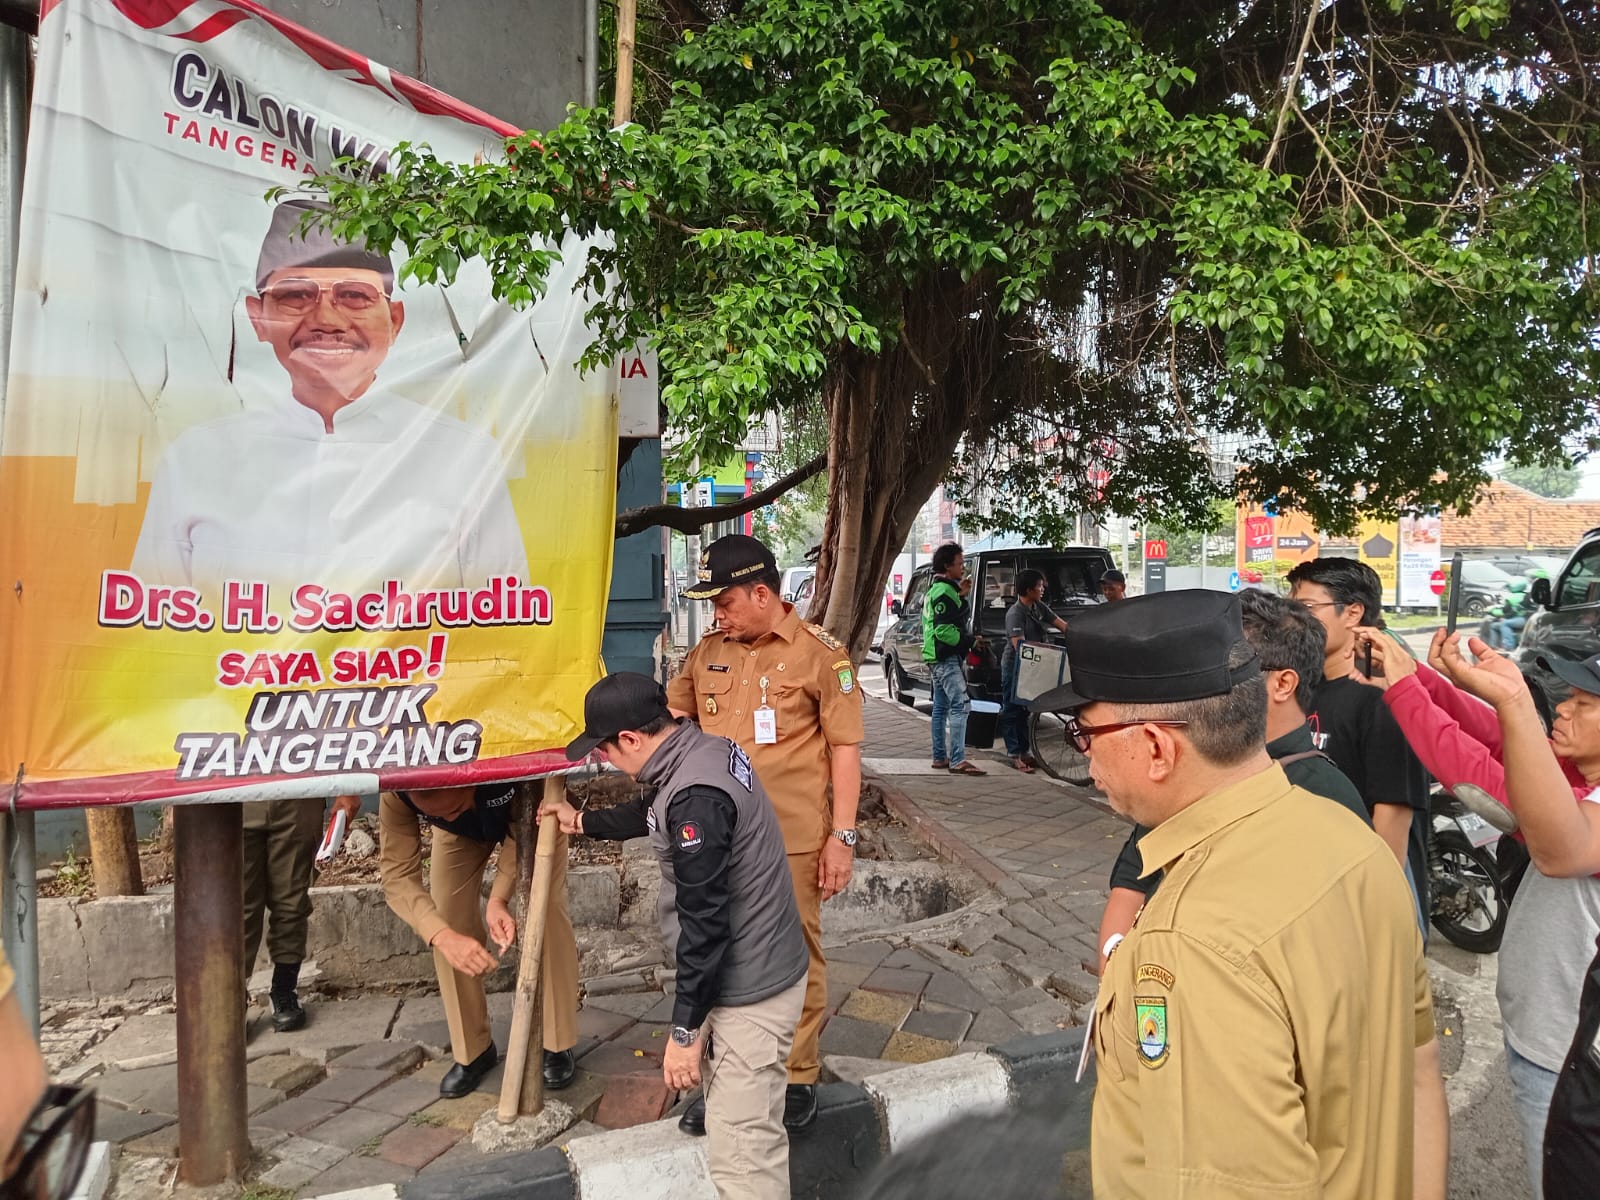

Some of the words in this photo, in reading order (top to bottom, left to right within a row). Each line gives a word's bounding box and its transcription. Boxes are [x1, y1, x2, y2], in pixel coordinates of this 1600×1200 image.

[163, 111, 330, 178] TANGERA
[172, 51, 317, 161] CALON
[331, 126, 392, 182] WA
[621, 358, 648, 378] IA
[102, 572, 212, 626] Drs.
[226, 581, 279, 628] H.
[292, 575, 550, 627] Sachrudin
[218, 651, 322, 686] SAYA
[249, 686, 432, 732] UNTUK
[179, 723, 479, 779] TANGERANG
